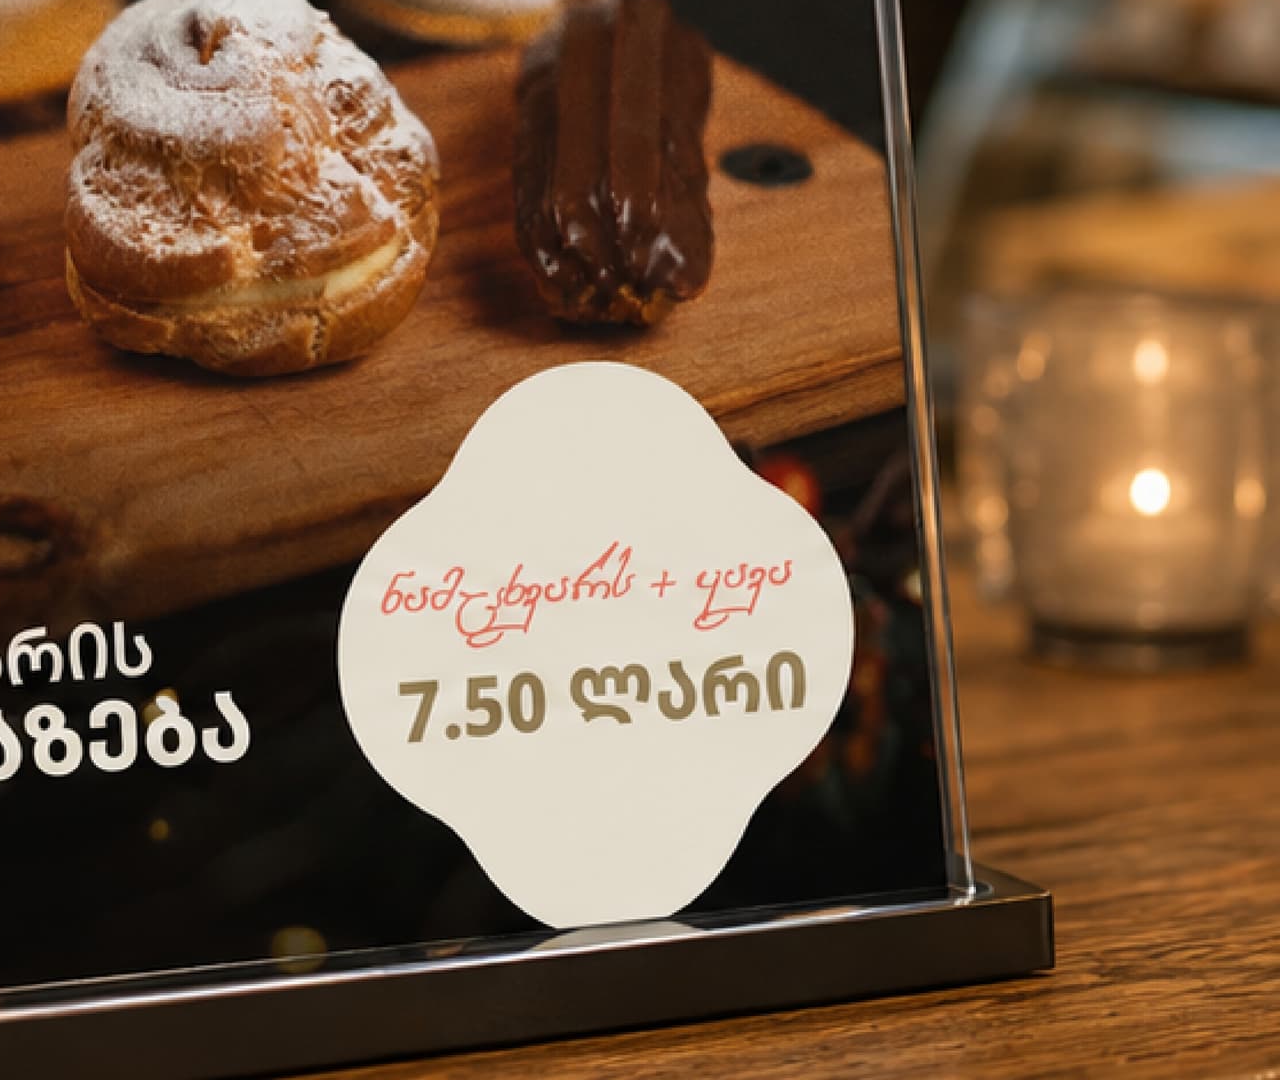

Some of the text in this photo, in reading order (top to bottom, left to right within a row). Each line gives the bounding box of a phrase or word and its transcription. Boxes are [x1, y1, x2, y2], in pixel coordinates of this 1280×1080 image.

[650, 570, 677, 599] +
[692, 559, 794, 632] ყავა
[398, 651, 808, 744] 7.50 ლარი
